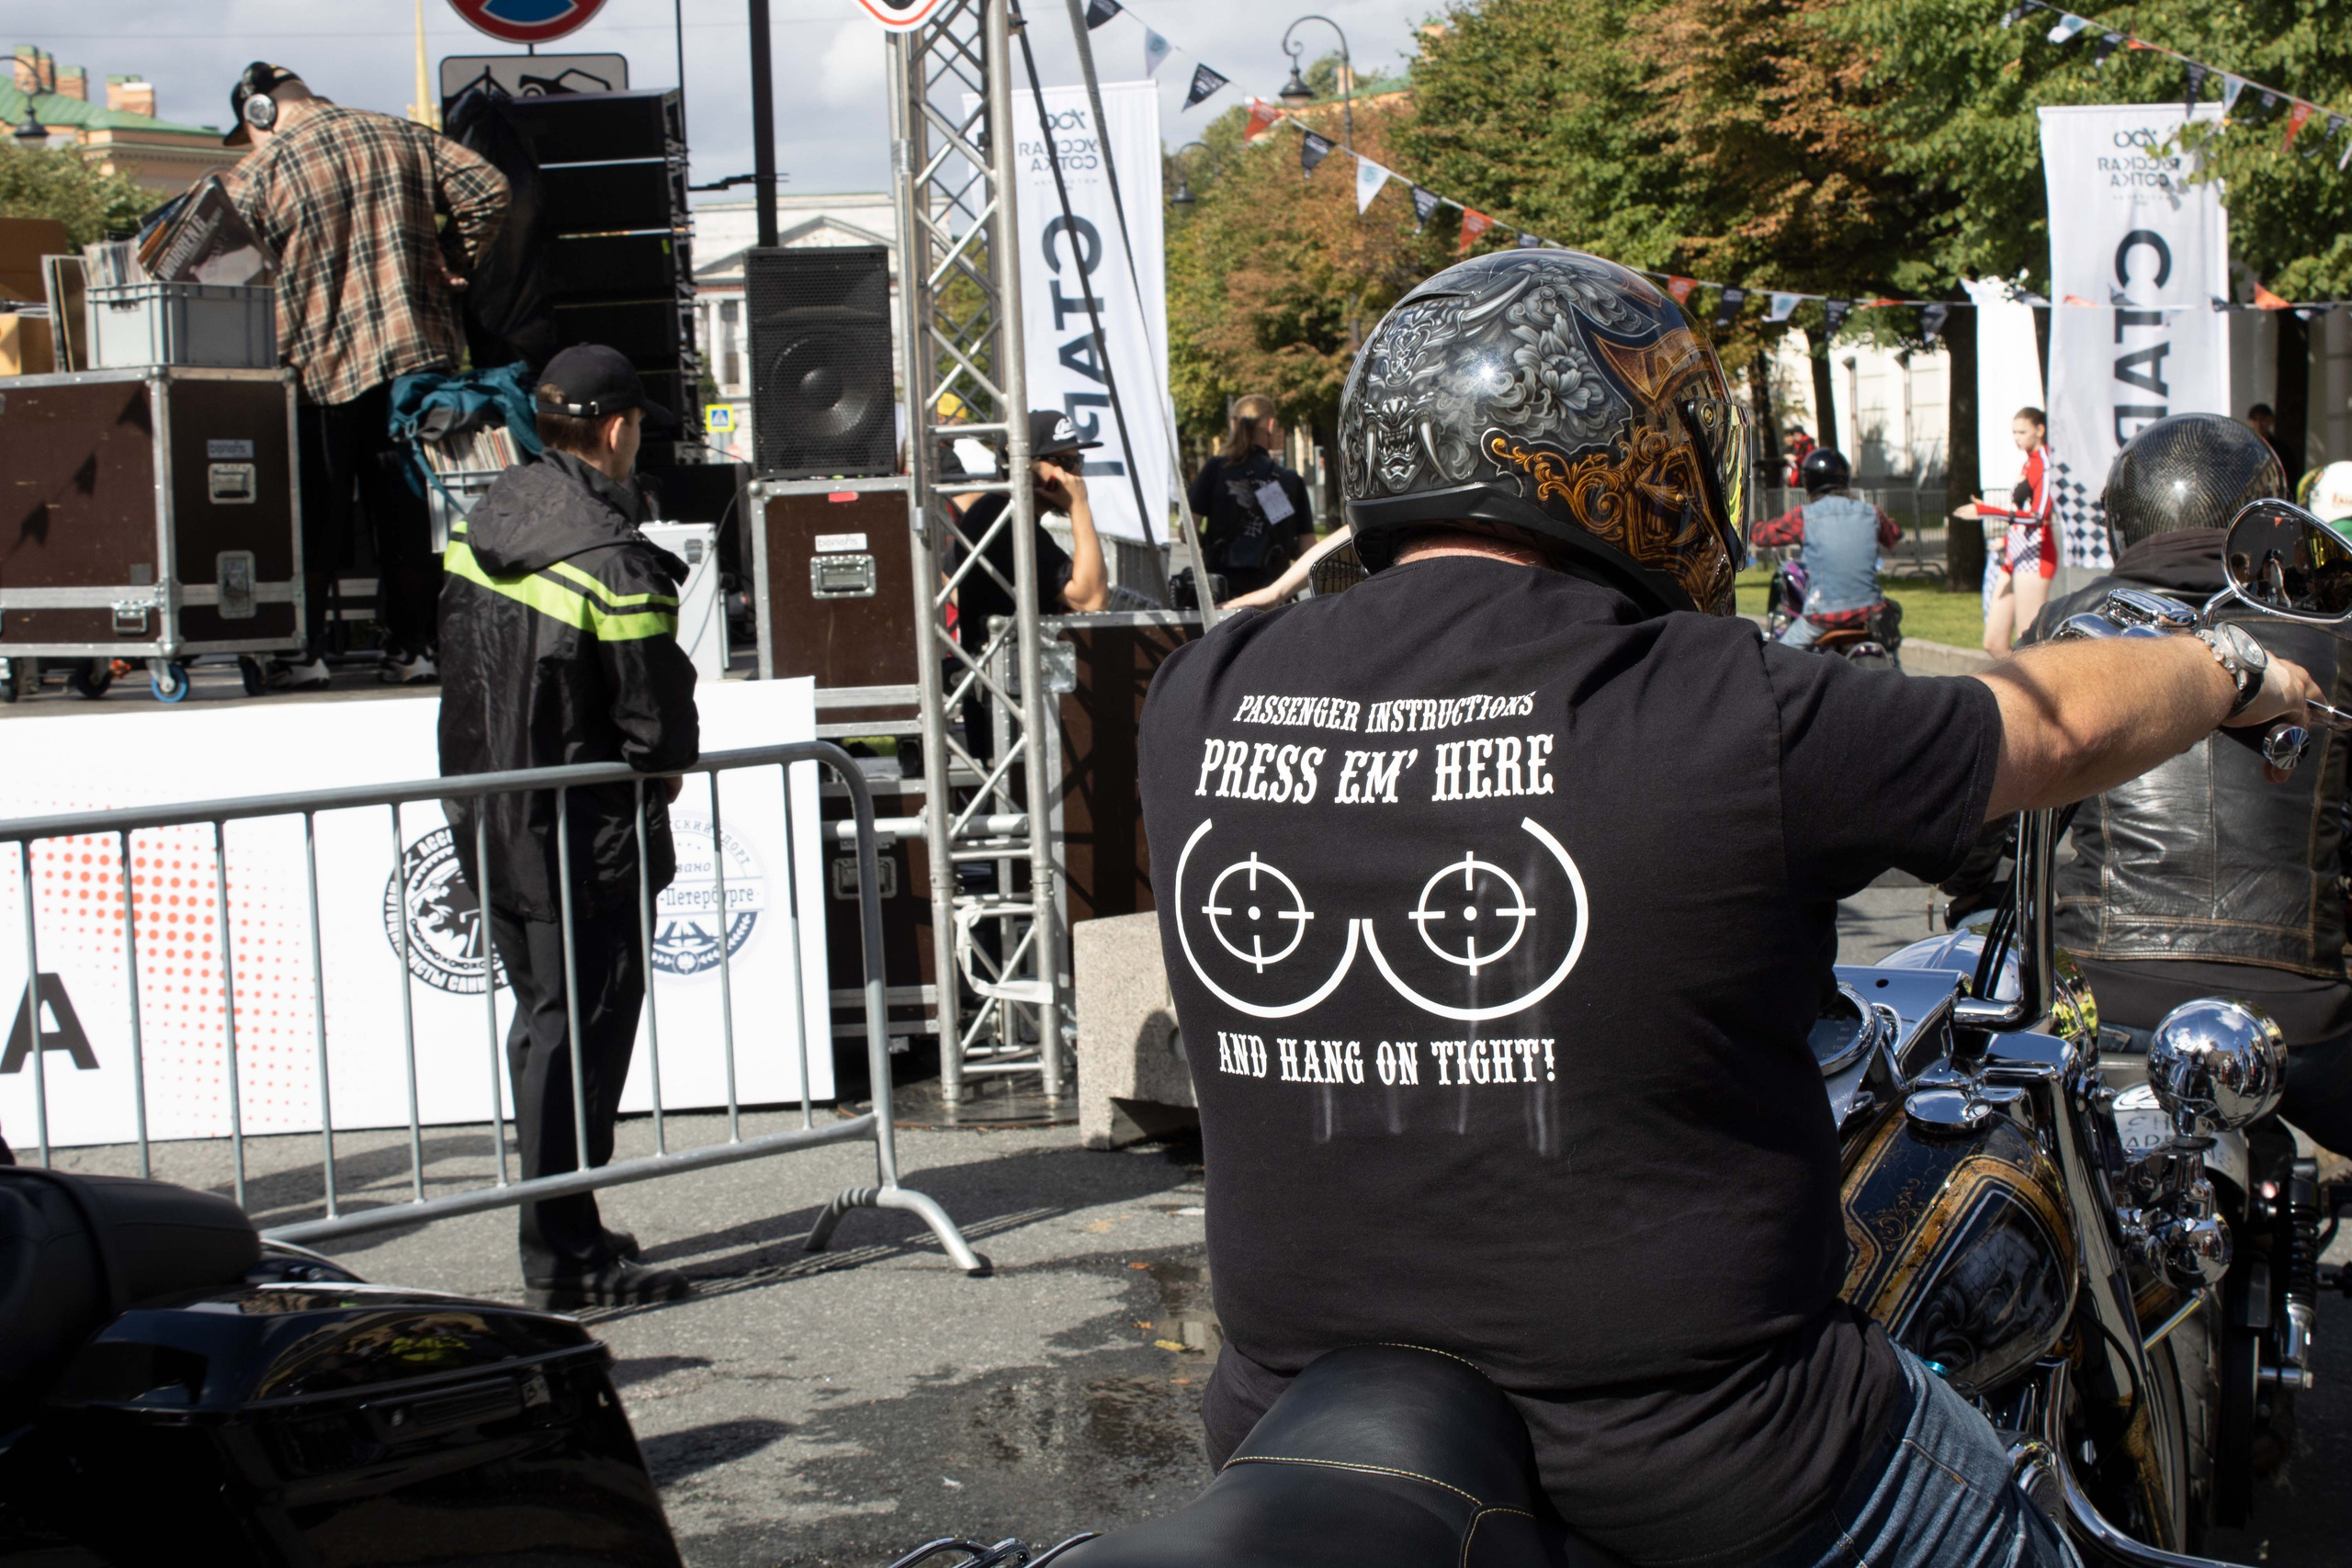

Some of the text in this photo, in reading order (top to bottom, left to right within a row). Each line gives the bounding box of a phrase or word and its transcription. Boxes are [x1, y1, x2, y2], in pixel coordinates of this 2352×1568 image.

[1232, 690, 1537, 733] PASSENGER INSTRUCTIONS
[1194, 733, 1555, 805] PRESS EM' HERE
[1217, 1031, 1556, 1086] AND HANG ON TIGHT!
